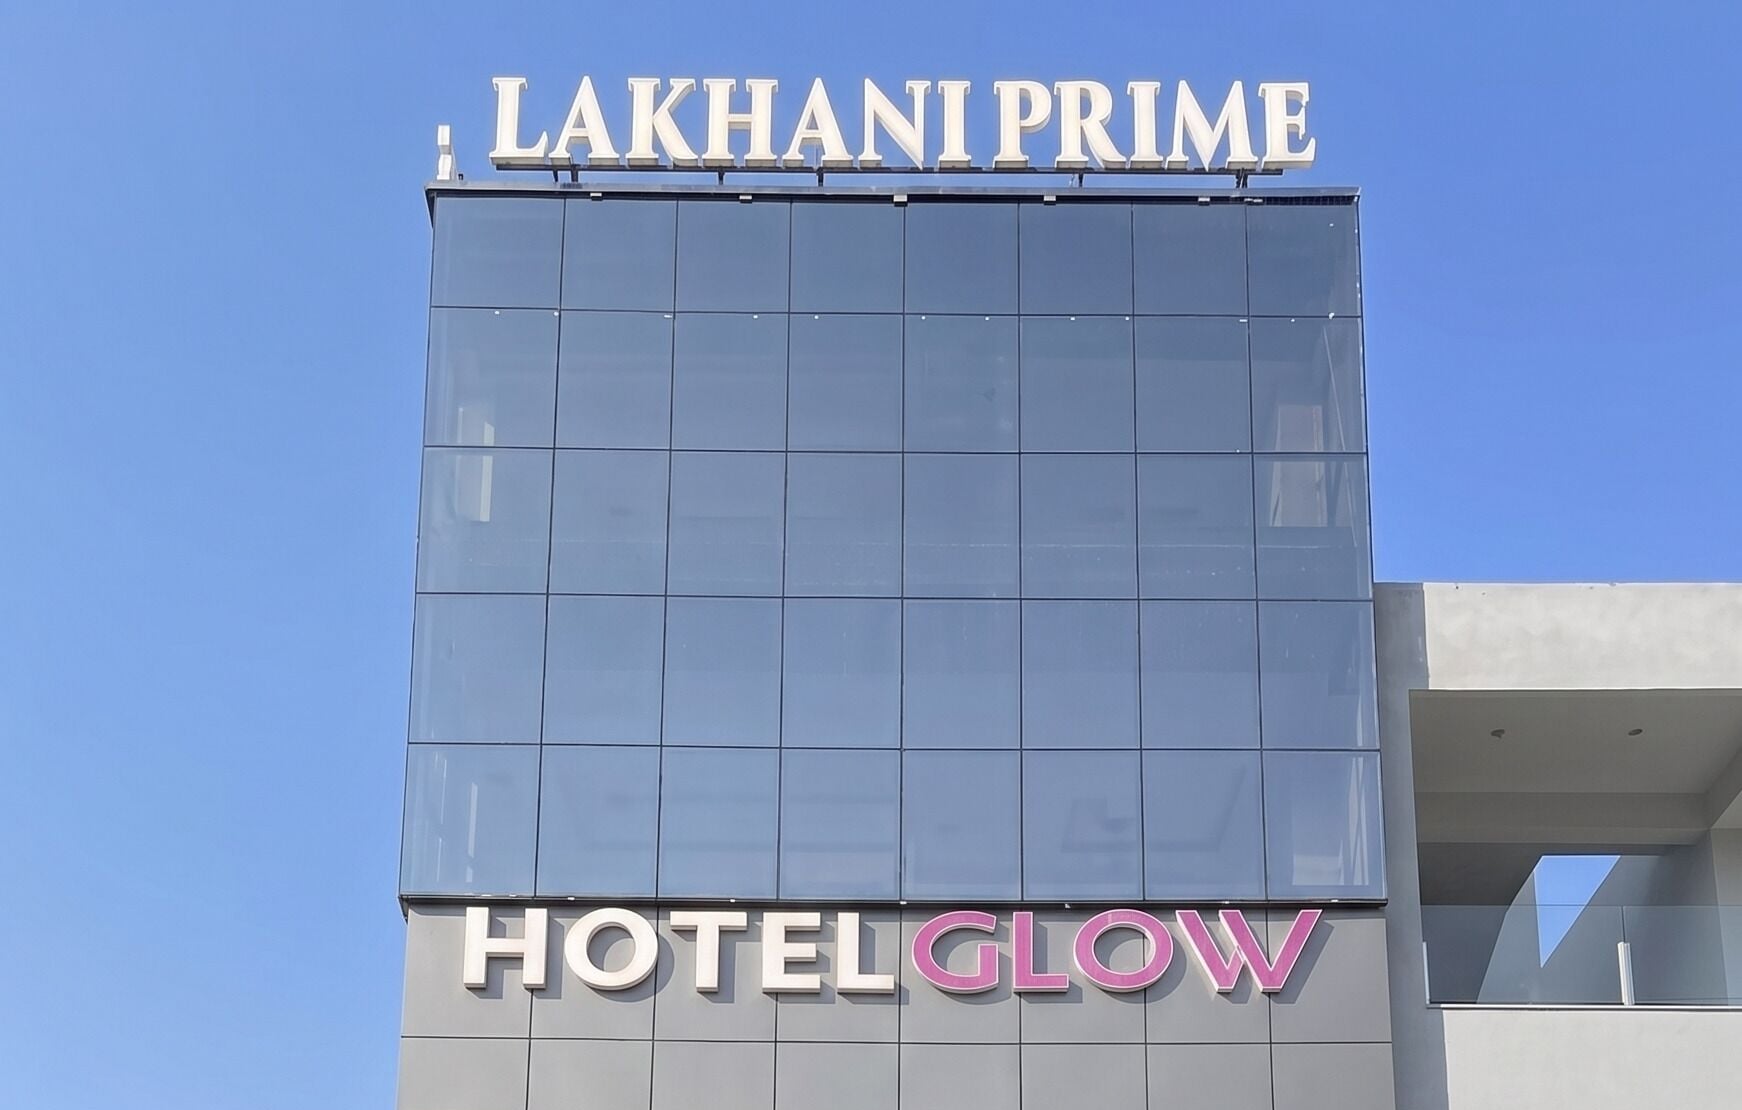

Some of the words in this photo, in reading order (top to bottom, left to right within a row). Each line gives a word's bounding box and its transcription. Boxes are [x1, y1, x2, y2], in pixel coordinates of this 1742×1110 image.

[490, 75, 971, 169] LAKHANI
[993, 79, 1317, 169] PRIME
[462, 907, 895, 994] HOTEL
[911, 909, 1324, 994] GLOW
